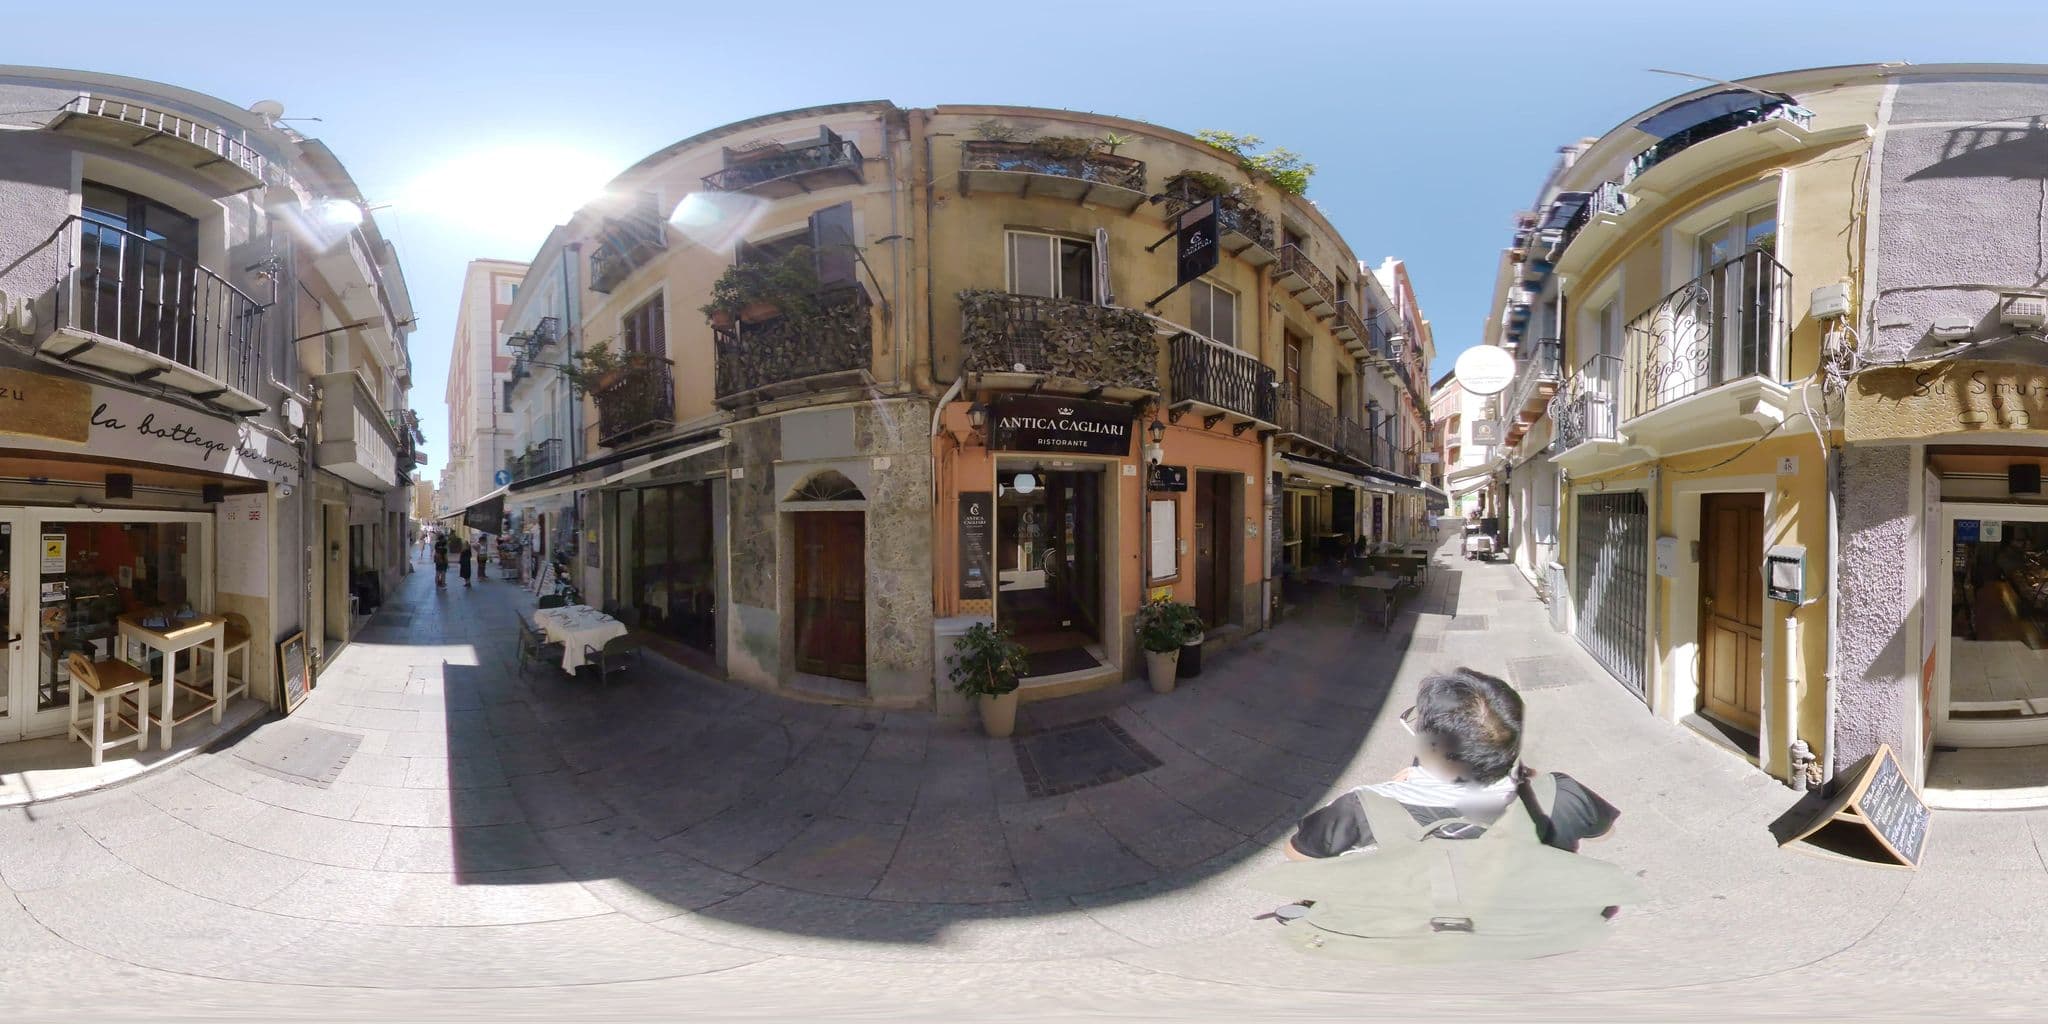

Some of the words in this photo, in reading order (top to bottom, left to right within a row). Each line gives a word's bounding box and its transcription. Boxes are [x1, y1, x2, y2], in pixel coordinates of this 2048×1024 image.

[1914, 371, 1946, 398] Su
[1970, 369, 2048, 398] Smur
[90, 402, 126, 430] la
[137, 413, 229, 462] bottega
[235, 445, 258, 461] dei
[999, 416, 1057, 430] ANTICA
[1059, 419, 1124, 436] CAGLIARI
[1037, 438, 1088, 448] RISTORANTE
